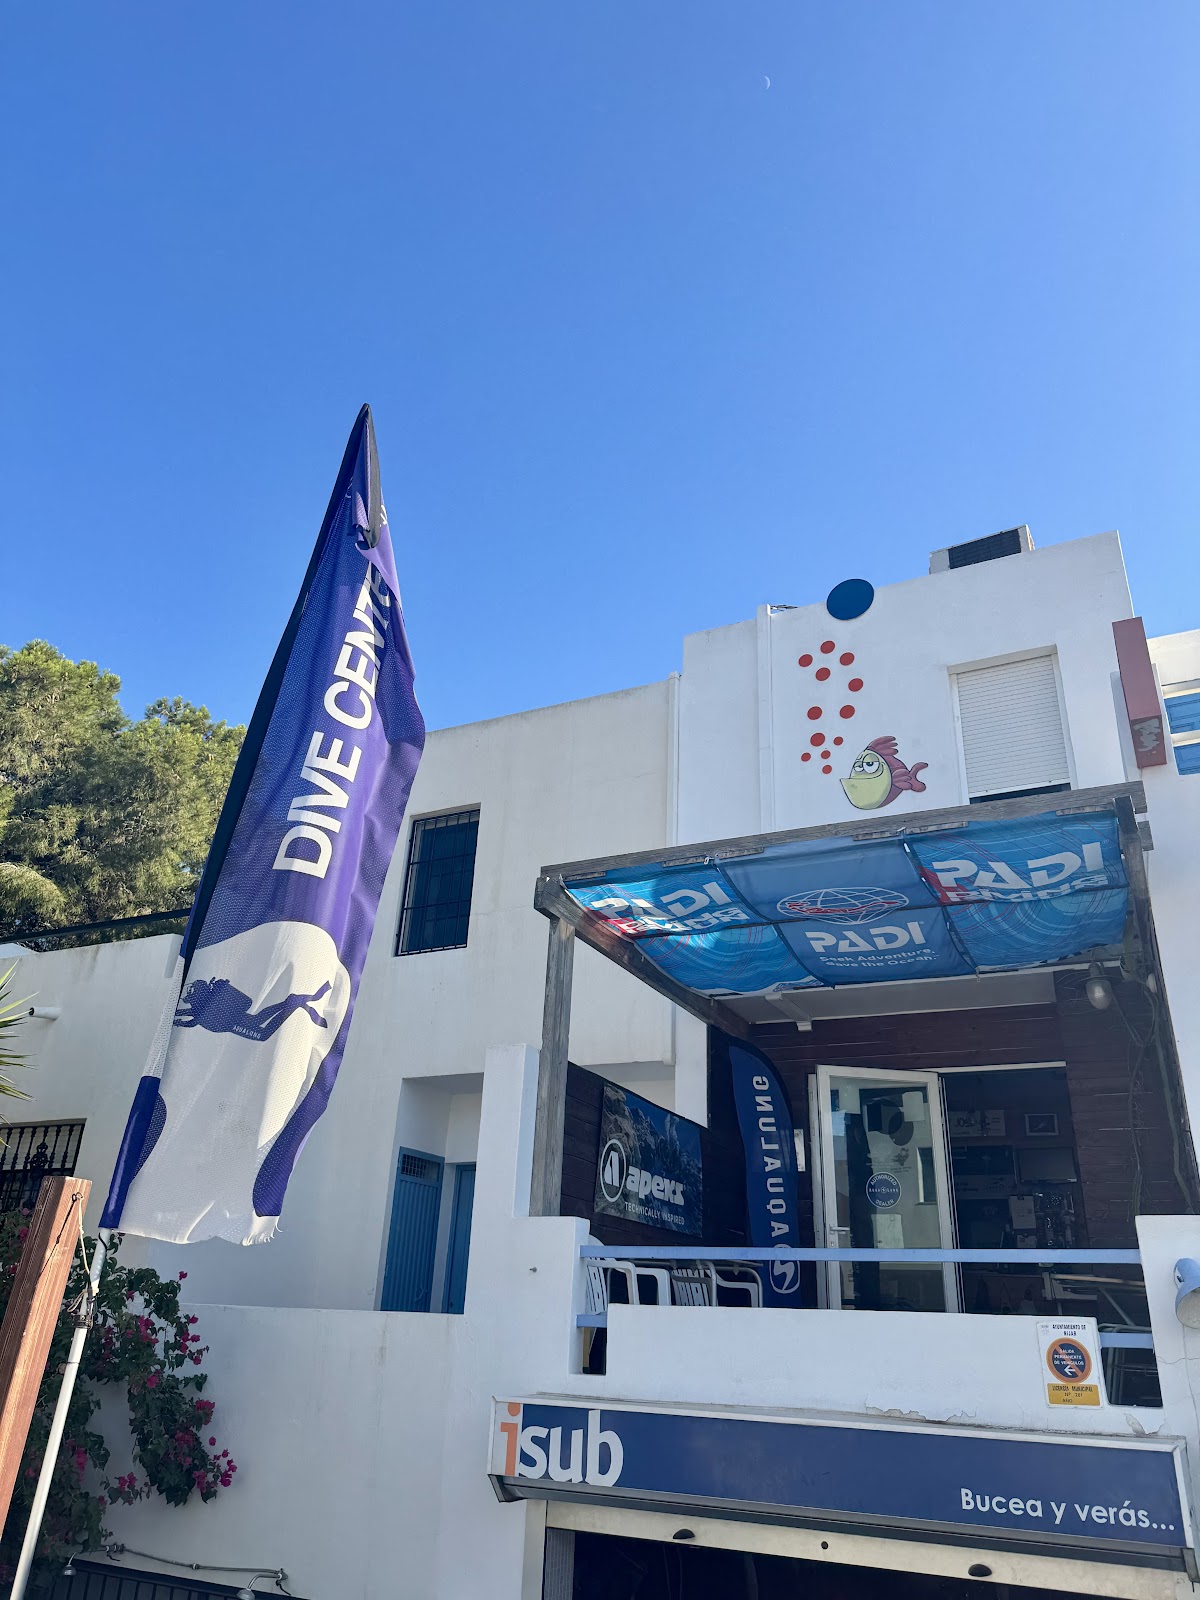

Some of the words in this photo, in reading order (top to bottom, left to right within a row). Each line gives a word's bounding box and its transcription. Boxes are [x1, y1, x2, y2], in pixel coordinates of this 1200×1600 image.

[272, 731, 362, 879] DIVE
[931, 841, 1105, 890] PADI
[590, 881, 733, 920] PADI
[804, 921, 926, 953] PADI
[857, 948, 936, 962] Adventure,
[626, 1165, 685, 1206] apeks
[870, 1174, 898, 1186] AUTHORIZED
[624, 1201, 661, 1219] TECHNICALLY
[662, 1211, 685, 1226] INSPIRED
[500, 1402, 624, 1488] isub
[960, 1487, 1043, 1518] Bucea
[1050, 1501, 1066, 1525] y
[1074, 1500, 1176, 1532] verás...
